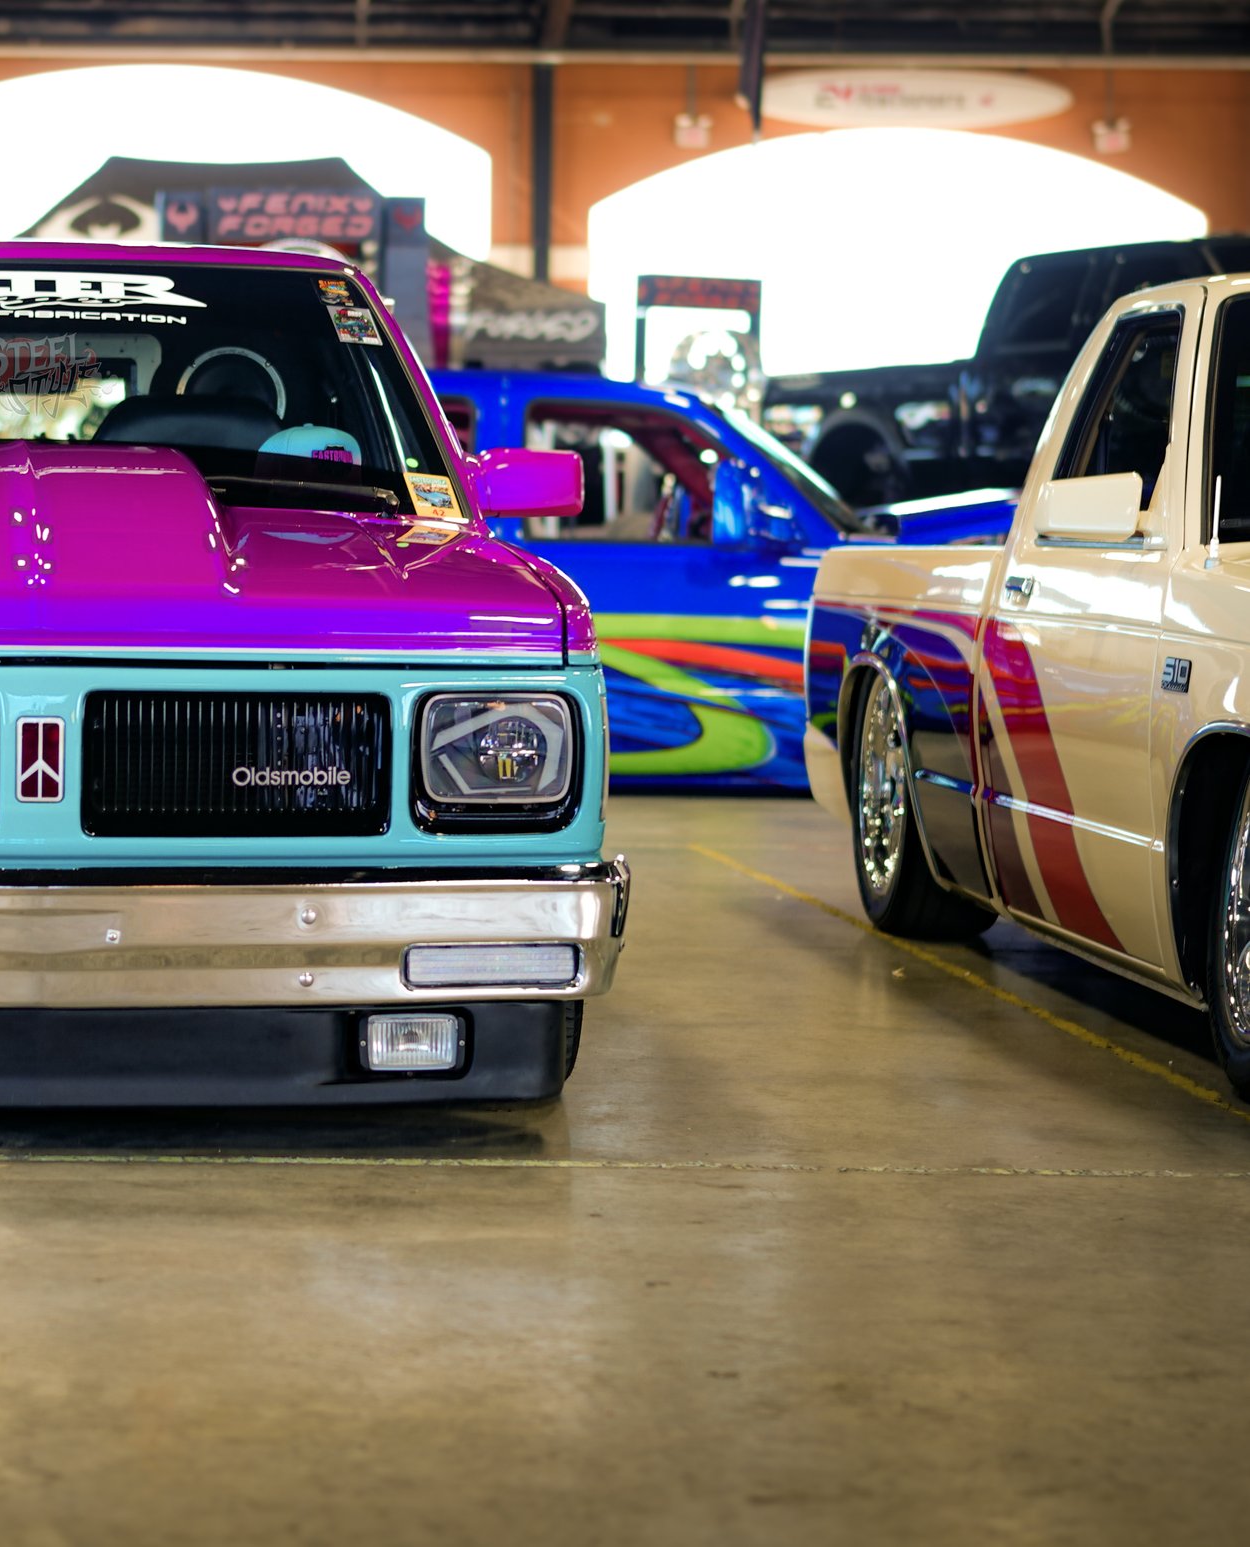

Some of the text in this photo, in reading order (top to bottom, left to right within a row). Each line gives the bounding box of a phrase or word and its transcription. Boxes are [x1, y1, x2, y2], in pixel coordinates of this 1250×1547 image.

[238, 192, 350, 215] FENIX
[217, 214, 374, 237] FORGED
[232, 766, 351, 787] Oldsmobile
